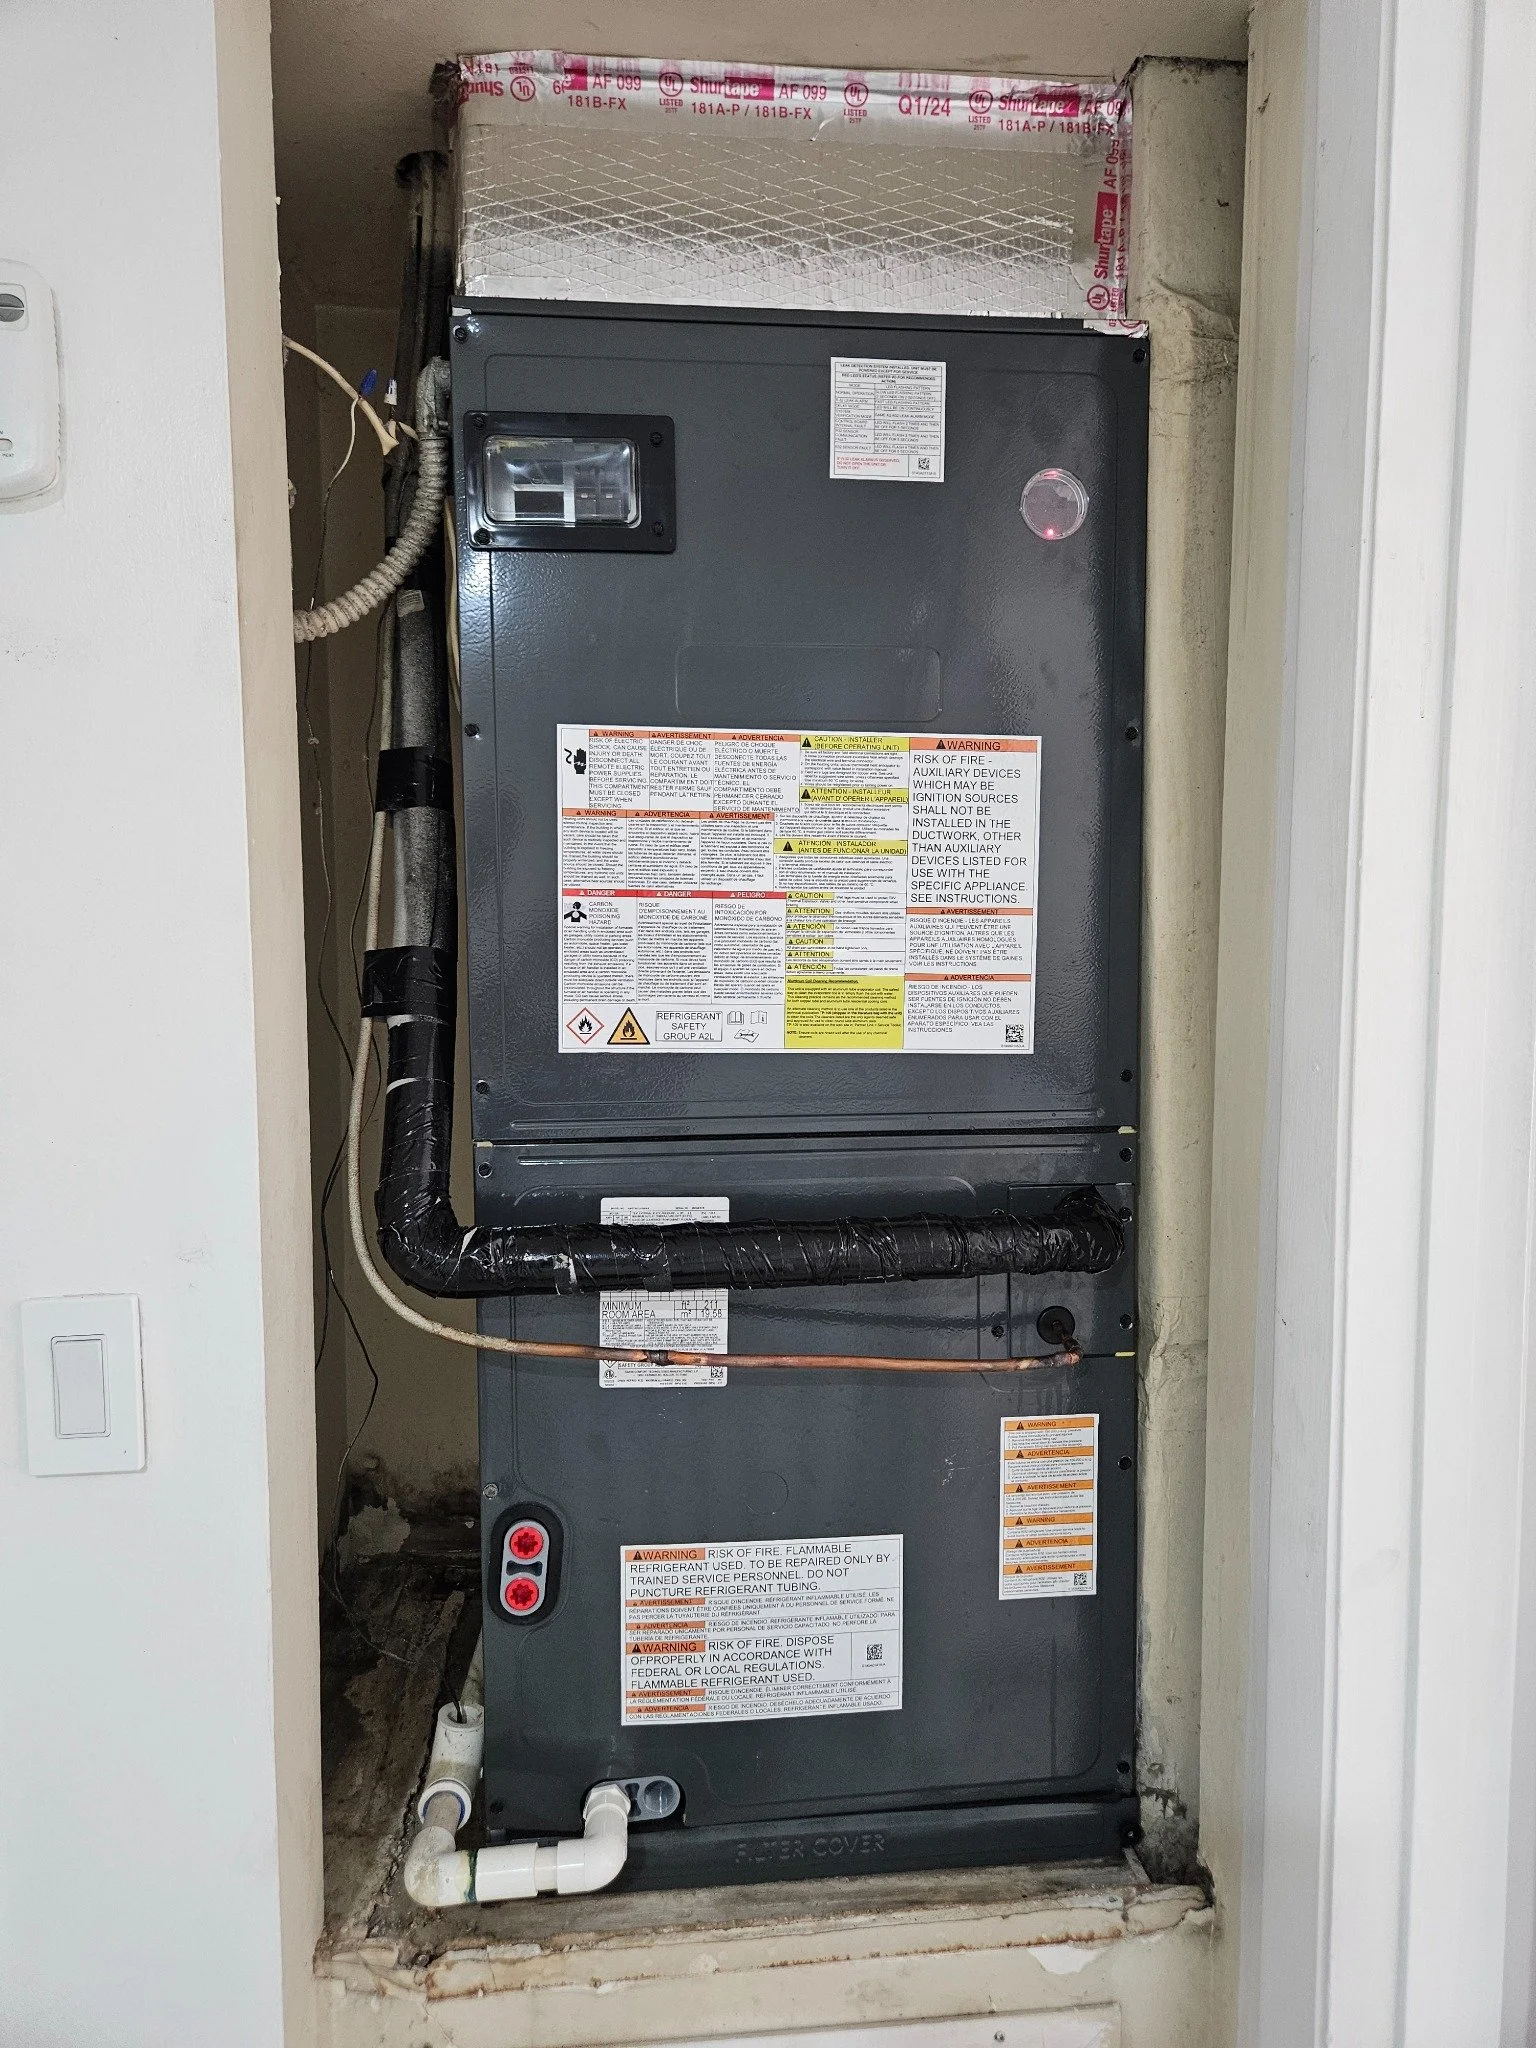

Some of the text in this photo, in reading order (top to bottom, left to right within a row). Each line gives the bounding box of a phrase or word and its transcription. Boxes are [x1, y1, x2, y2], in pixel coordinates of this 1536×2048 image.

[592, 75, 613, 89] AF
[617, 76, 642, 90] 099
[777, 83, 801, 99] AF
[802, 84, 828, 100] 099
[567, 95, 627, 110] 181B-FX
[659, 98, 683, 106] LISTED
[898, 96, 952, 117] Q1/24
[691, 102, 812, 119] 181A-P / 181B-FX
[968, 115, 991, 123] LISTED
[998, 119, 1046, 132] 181A-P
[1049, 121, 1055, 132] /
[1103, 168, 1117, 189] AF
[947, 740, 1000, 751] WARNING
[913, 754, 939, 763] RISK
[942, 754, 956, 764] OF
[960, 755, 985, 765] FIRE
[912, 767, 1020, 778] AUXILIARY DEVICES
[912, 779, 994, 790] WHICH MAY BE
[912, 792, 1018, 803] IGNITION SOURCES
[643, 810, 692, 818] ADVERTENCIA
[912, 805, 947, 814] SHALL
[950, 805, 973, 815] NOT
[976, 806, 991, 815] BE
[715, 812, 770, 820] AVERTISSEMENT
[912, 817, 1010, 828] INSTALLED IN THE
[912, 830, 1021, 841] DUCTWORK, OTHER
[911, 842, 1001, 853] THAN AUXILIARY
[911, 855, 1026, 865] DEVICES LISTED FOR
[911, 868, 989, 878] USE WITH THE
[910, 880, 1028, 891] SPECIFIC APPLIANCE.
[910, 892, 932, 902] SEE
[935, 893, 1019, 903] INSTRUCTIONS.
[794, 907, 832, 915] ATTENTION
[793, 922, 825, 930] ATENCIÓN
[793, 963, 828, 971] ATENCIÓN
[657, 1012, 721, 1020] REFRIGERANT
[671, 1022, 706, 1030] SAFETY
[662, 1032, 716, 1042] GROUP A2L
[602, 1301, 642, 1310] MINIMUM
[704, 1301, 719, 1310] 211
[602, 1310, 629, 1318] ROOM
[631, 1309, 655, 1318] AREA
[700, 1309, 722, 1318] 19.58
[1026, 1482, 1077, 1490] AVERTISSEMENT
[642, 1549, 697, 1560] WARNING
[707, 1548, 733, 1558] RISK
[736, 1548, 751, 1557] OF
[785, 1543, 851, 1555] FLAMMABLE
[630, 1561, 709, 1573] REFRIGERANT
[749, 1559, 765, 1568] TO
[767, 1558, 782, 1568] BE
[785, 1556, 841, 1567] REPAIRED
[843, 1554, 873, 1564] ONLY
[875, 1553, 890, 1562] BY
[1025, 1563, 1075, 1571] AVERTISSEMENT
[630, 1575, 679, 1585] TRAINED
[681, 1573, 730, 1584] SERVICE
[807, 1569, 823, 1578] DO
[826, 1567, 849, 1577] NOT
[630, 1581, 820, 1597] PUNCTURE REFRIGERANT TUBING.
[639, 1598, 693, 1606] AVERTISSEMENT
[642, 1642, 696, 1652] WARNING
[708, 1640, 734, 1650] RISK
[736, 1639, 752, 1649] OF
[786, 1635, 834, 1646] DISPOSE
[630, 1647, 832, 1665] OFPROPERLY IN ACCORDANCE WITH
[631, 1659, 824, 1677] FEDERAL OR LOCAL REGULATIONS.
[631, 1678, 697, 1689] FLAMMABLE
[700, 1674, 779, 1687] REFRIGERANT
[638, 1689, 693, 1697] AVERTISSEMENT
[813, 1833, 885, 1856] COVER
